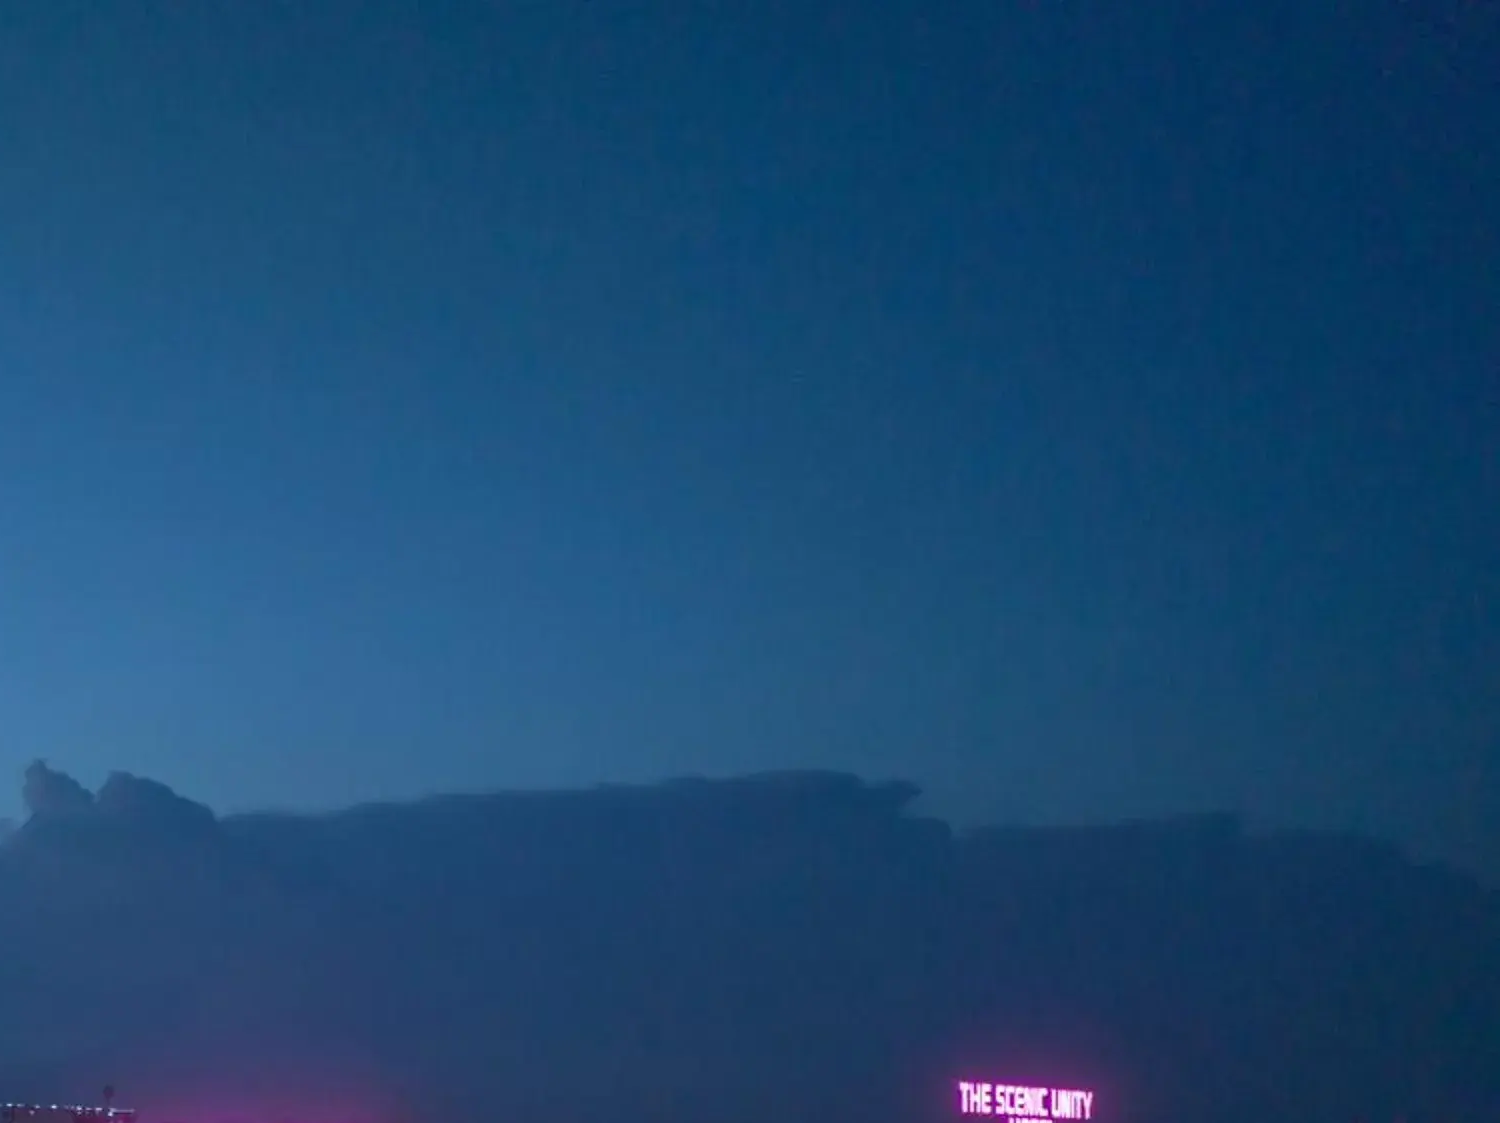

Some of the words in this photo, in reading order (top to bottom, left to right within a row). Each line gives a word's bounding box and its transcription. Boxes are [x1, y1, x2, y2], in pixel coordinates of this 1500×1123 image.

[959, 1082, 992, 1114] THE
[995, 1084, 1049, 1116] SCENIC
[1051, 1088, 1093, 1119] UNITY
